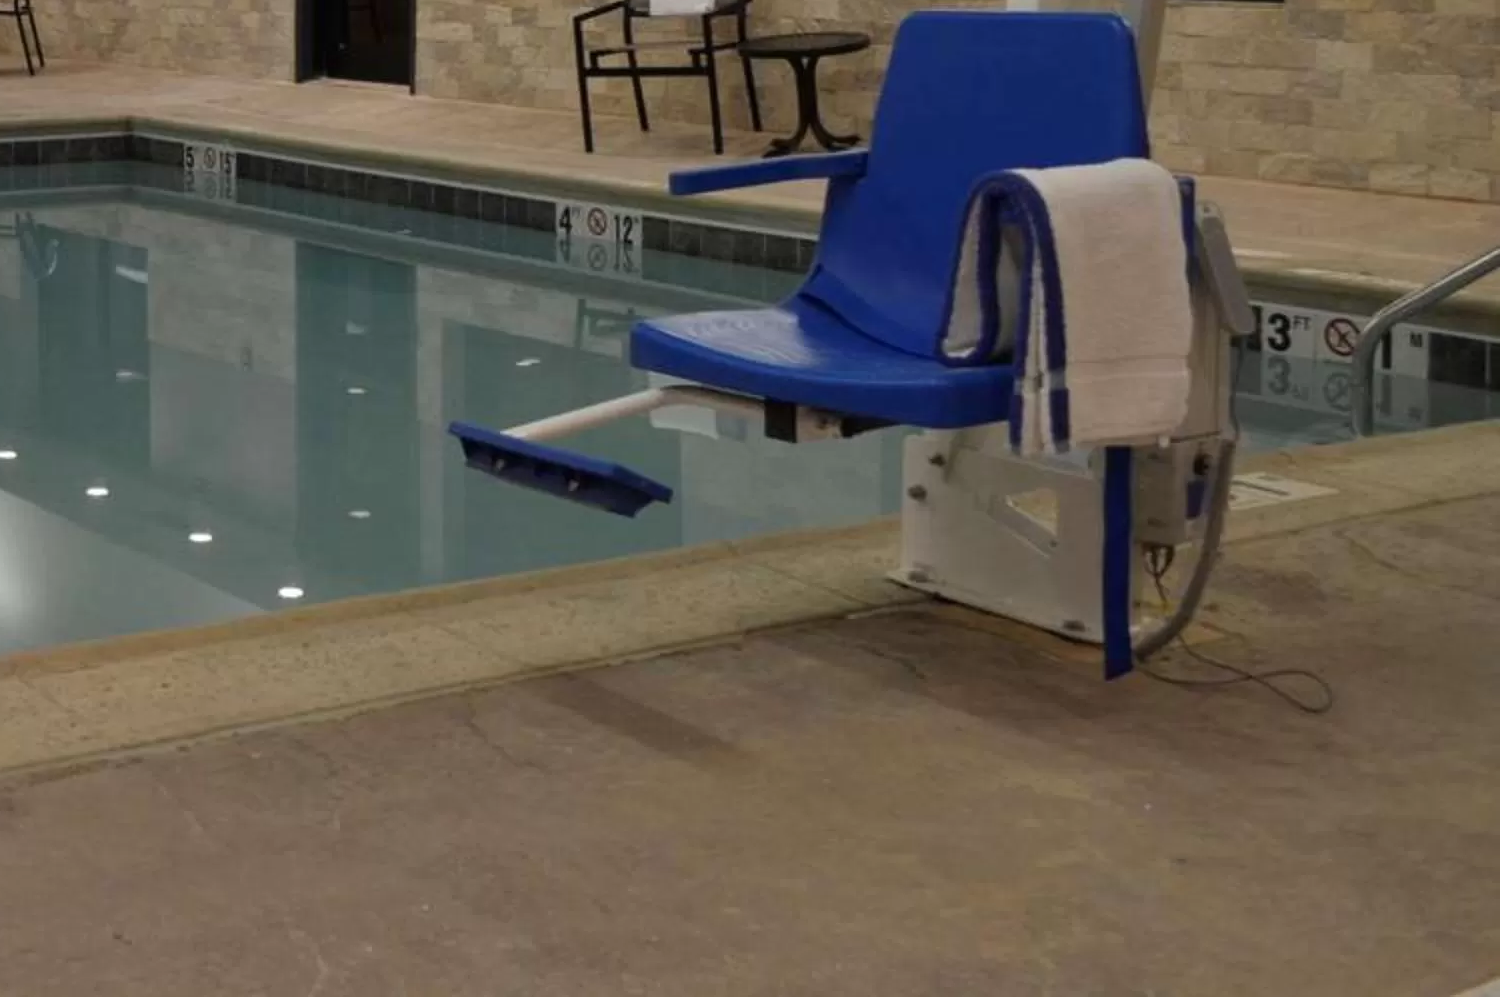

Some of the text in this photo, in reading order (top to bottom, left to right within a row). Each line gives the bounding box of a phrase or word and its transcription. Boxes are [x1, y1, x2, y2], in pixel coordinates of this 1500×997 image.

[559, 206, 572, 234] 4
[1268, 313, 1291, 351] 3
[1293, 315, 1311, 330] FT
[1408, 332, 1422, 348] M
